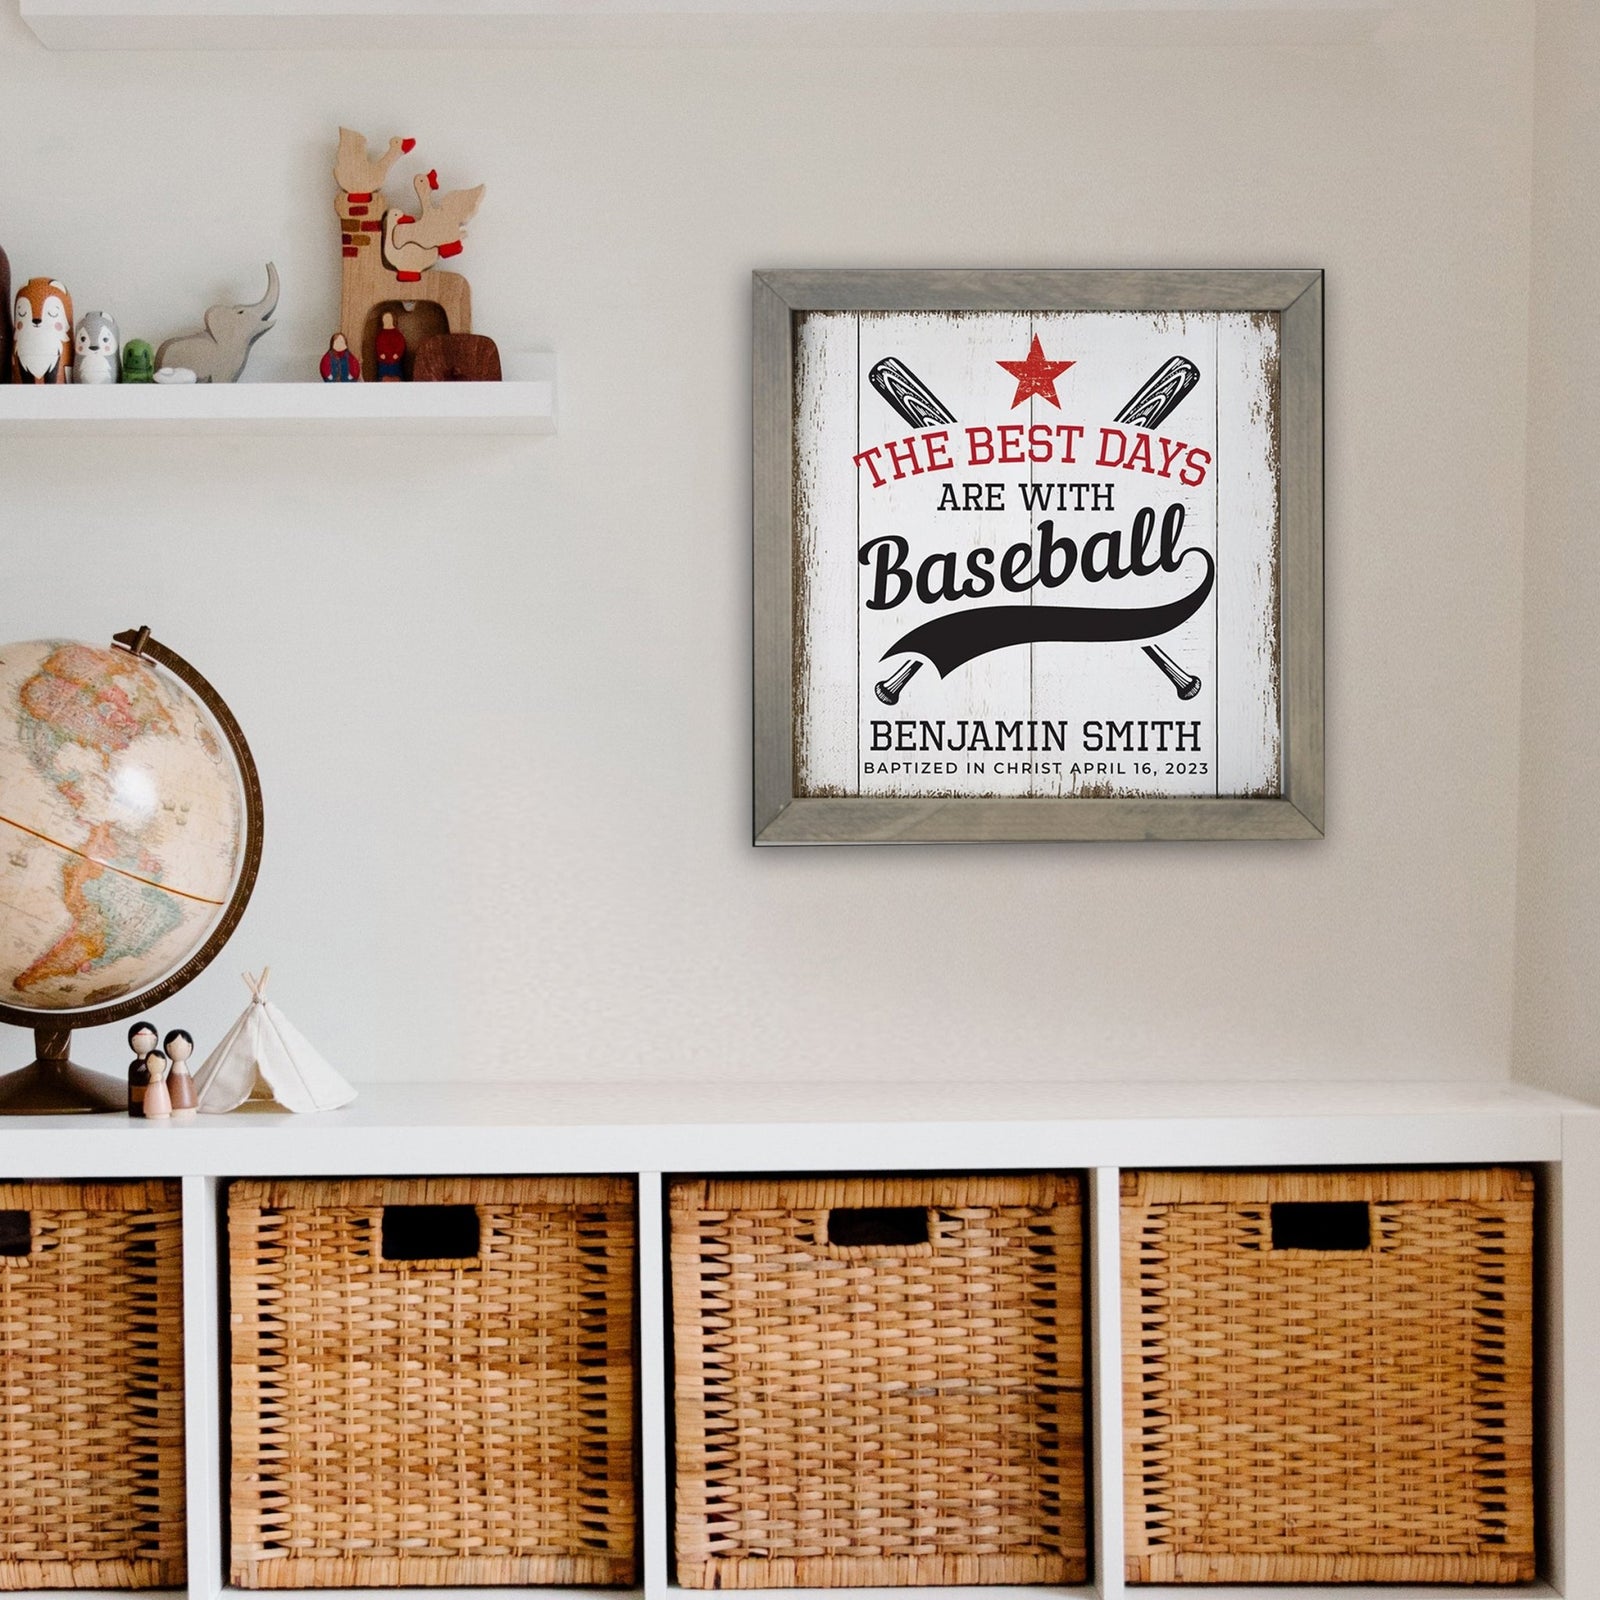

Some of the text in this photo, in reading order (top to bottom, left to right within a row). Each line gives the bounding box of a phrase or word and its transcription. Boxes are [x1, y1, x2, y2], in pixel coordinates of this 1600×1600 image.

[852, 424, 1212, 489] THE BEST DAYS
[936, 483, 1115, 511] ARE WITH
[858, 502, 1188, 611] Baseball
[870, 720, 1202, 752] BENJAMIN SMITH
[864, 762, 1208, 777] BAPTIZED IN CHRIST APRIL 16, 2023
